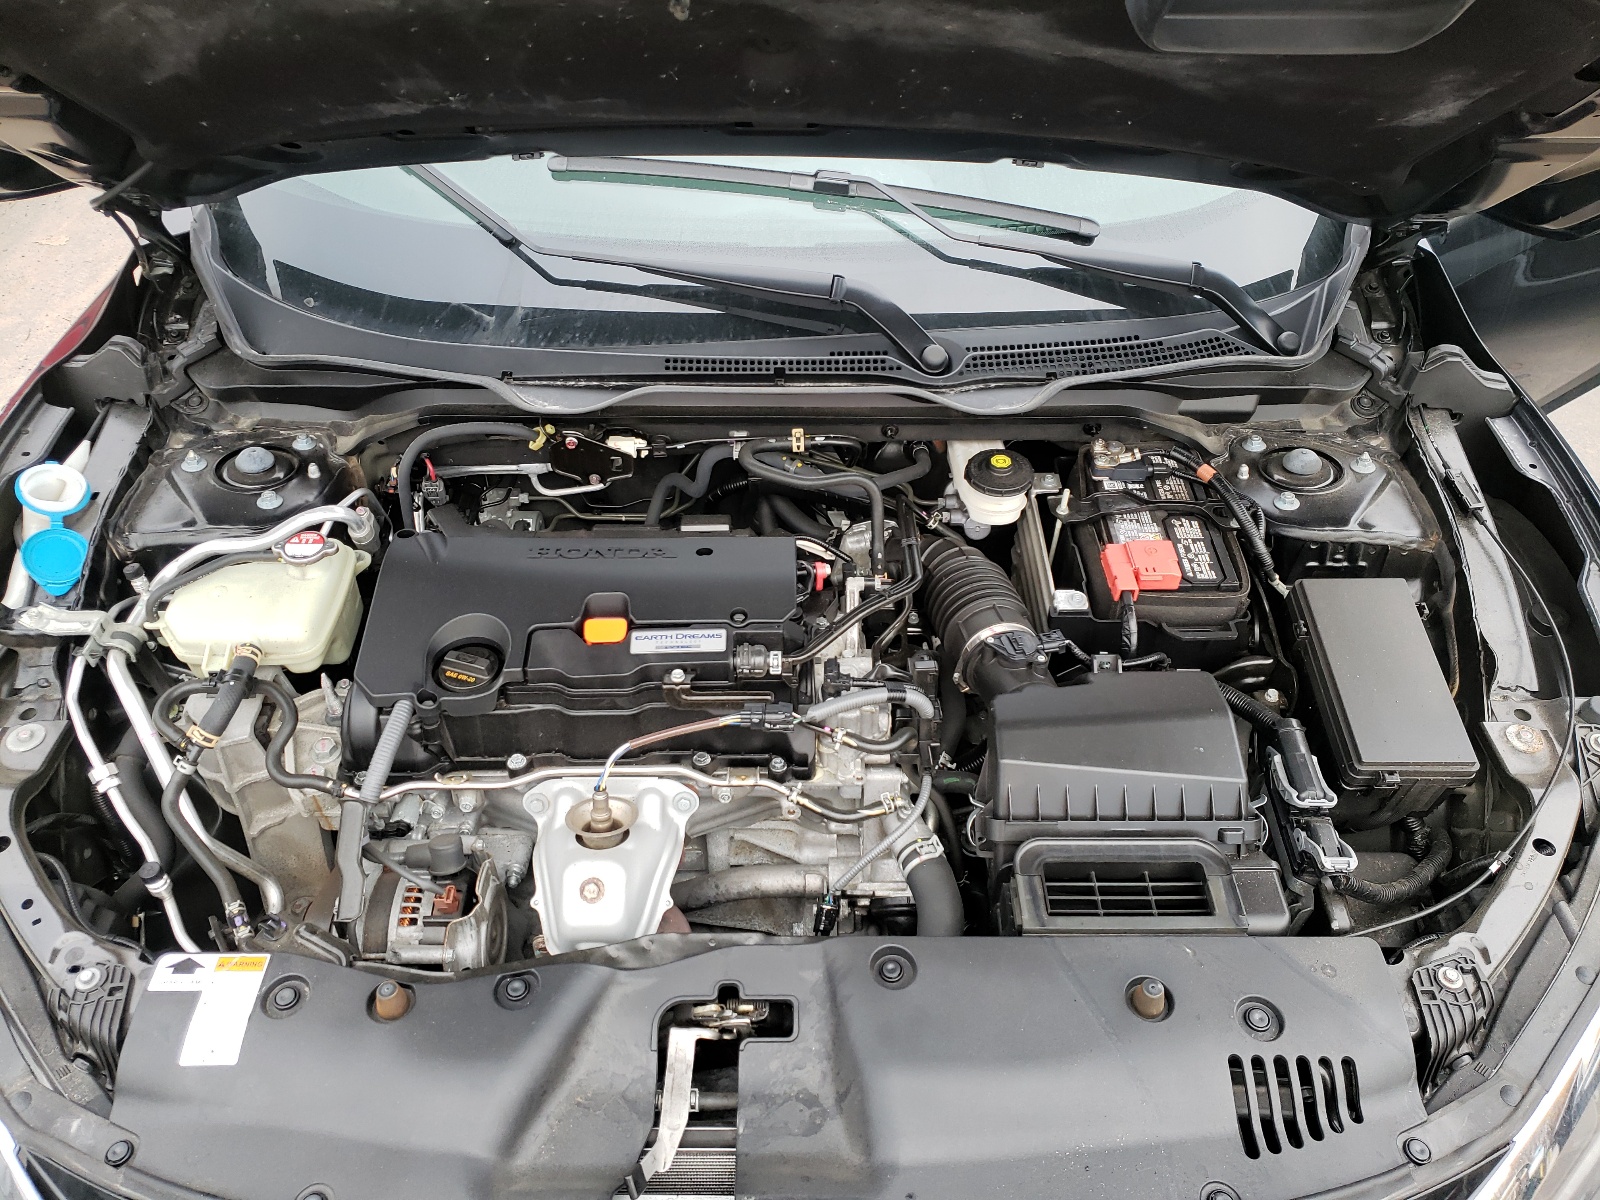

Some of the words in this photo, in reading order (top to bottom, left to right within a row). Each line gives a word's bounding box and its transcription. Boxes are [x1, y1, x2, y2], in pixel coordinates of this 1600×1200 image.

[527, 547, 678, 559] HONDA
[635, 633, 673, 641] EARTH
[675, 632, 723, 640] DREAMS
[446, 670, 459, 679] SAE
